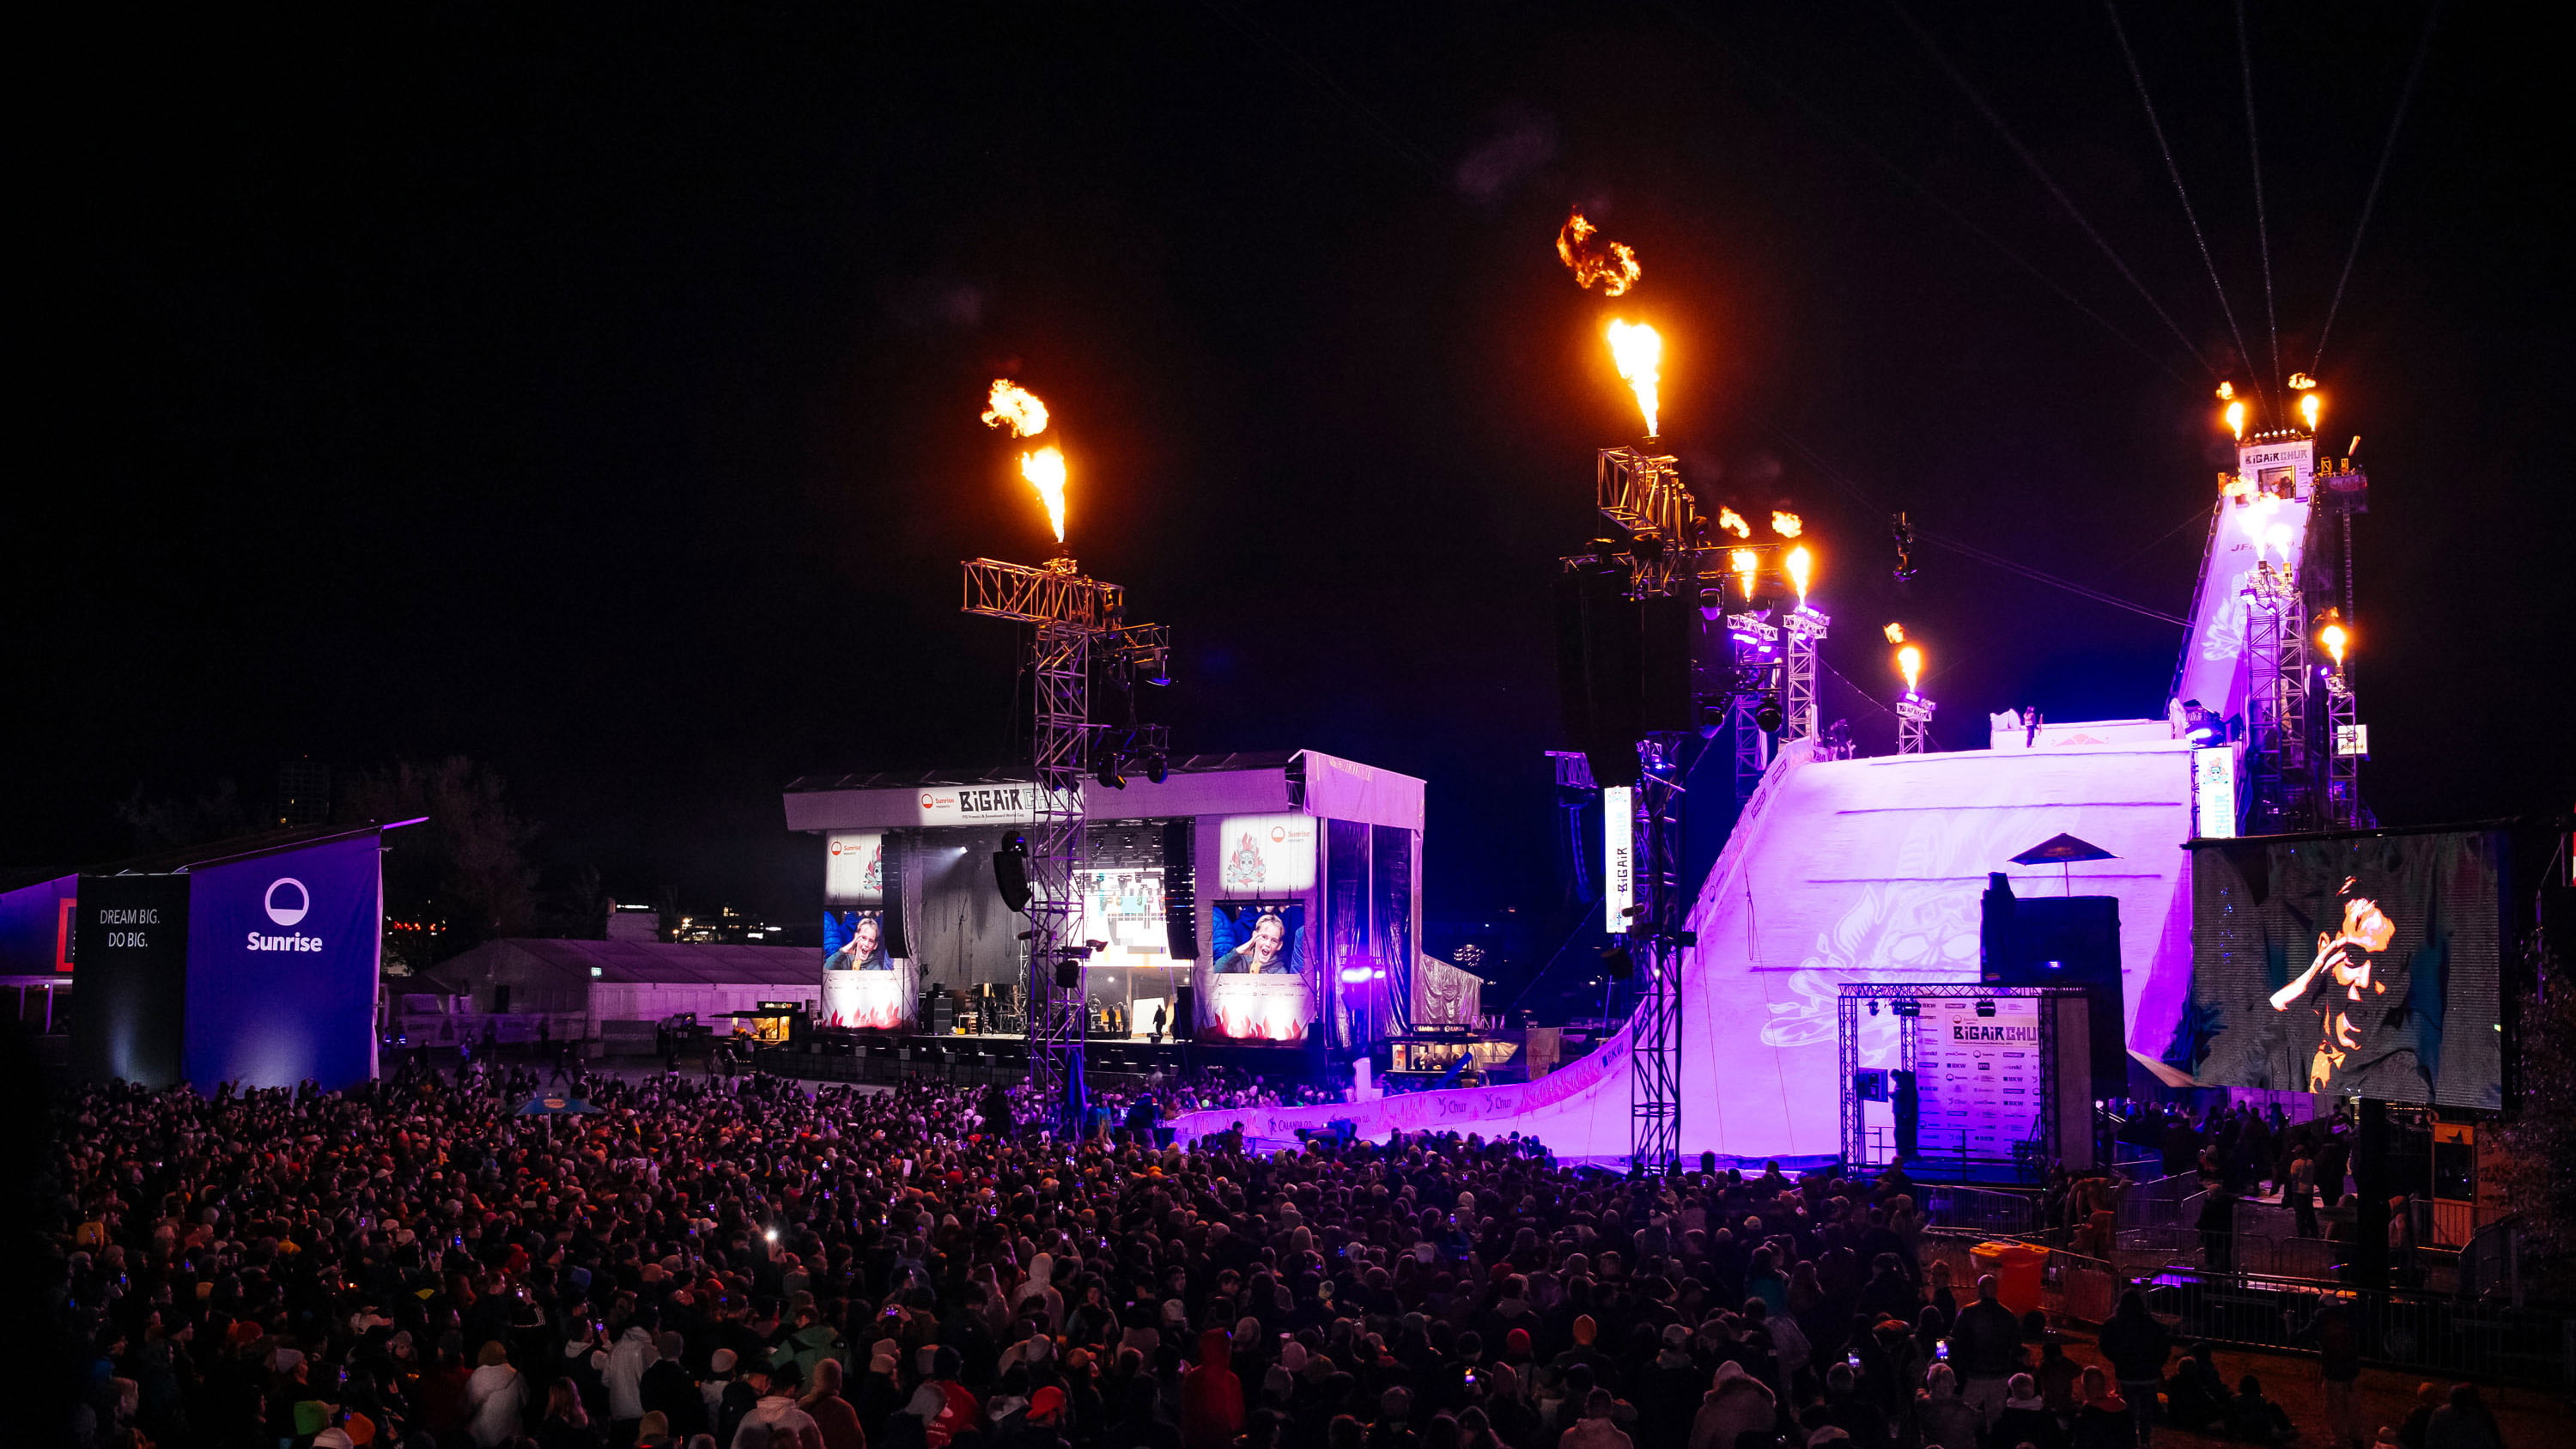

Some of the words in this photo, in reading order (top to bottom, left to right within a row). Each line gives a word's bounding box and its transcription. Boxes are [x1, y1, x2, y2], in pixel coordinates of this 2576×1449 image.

[100, 909, 137, 925] DREAM
[140, 909, 161, 924] BIG.
[108, 932, 125, 947] DO
[128, 932, 149, 947] BIG.
[247, 931, 323, 952] Sunrise
[2006, 1026, 2038, 1041] CHU
[1608, 1043, 1624, 1062] BKW
[1449, 1100, 1467, 1114] Chur
[1496, 1096, 1511, 1110] Chur
